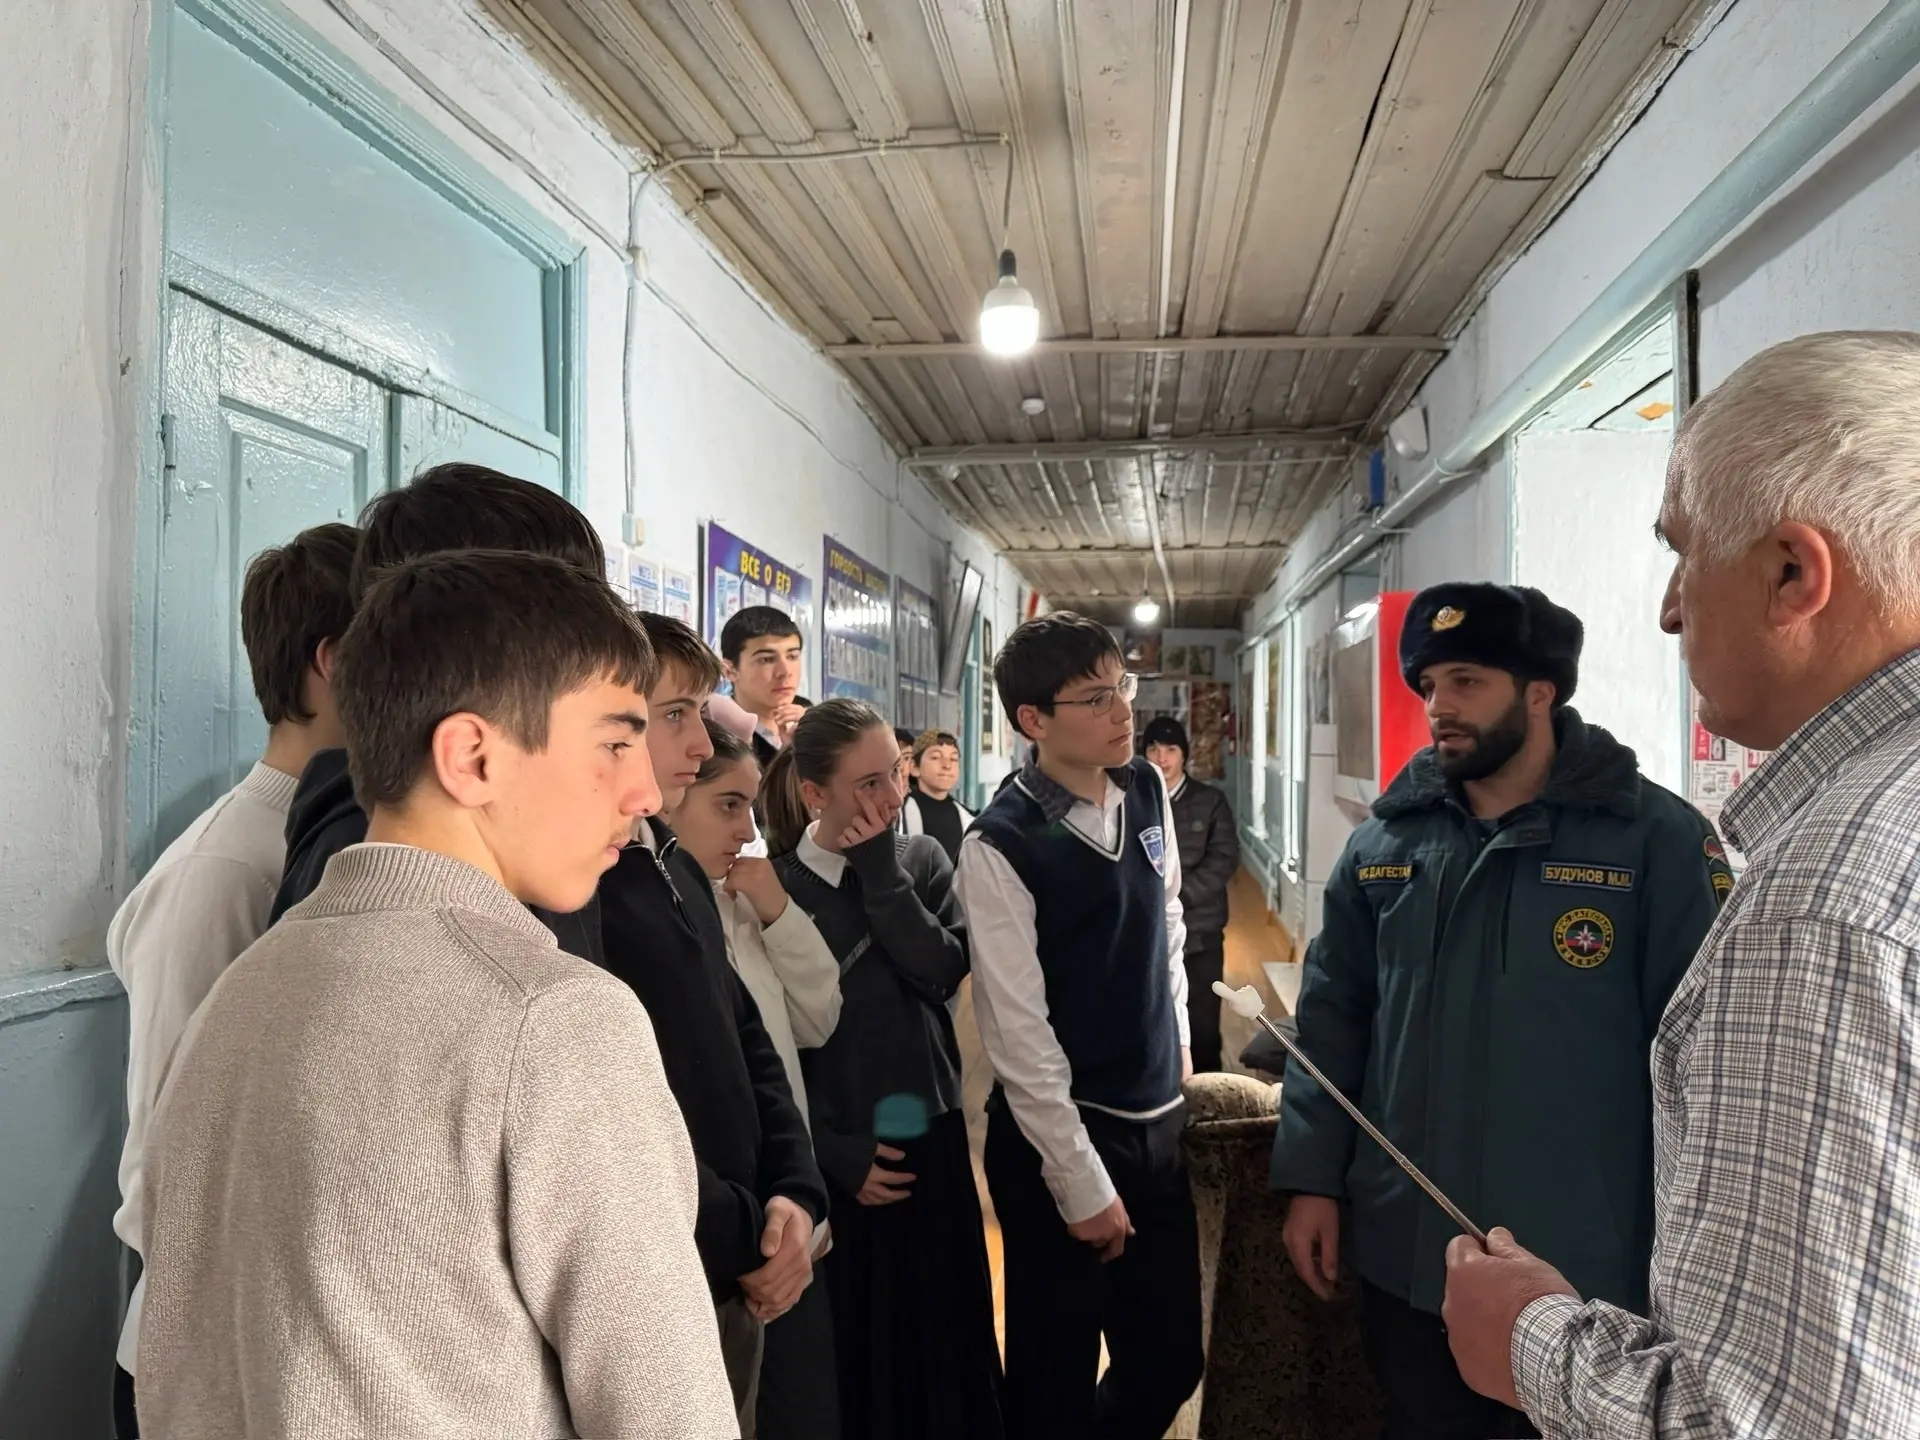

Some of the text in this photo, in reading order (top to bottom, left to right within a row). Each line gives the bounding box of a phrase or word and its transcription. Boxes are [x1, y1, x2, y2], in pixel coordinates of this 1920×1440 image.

[740, 549, 792, 595] ВСЕ О ЕГЭ
[1544, 866, 1604, 884] БУДУНОВ
